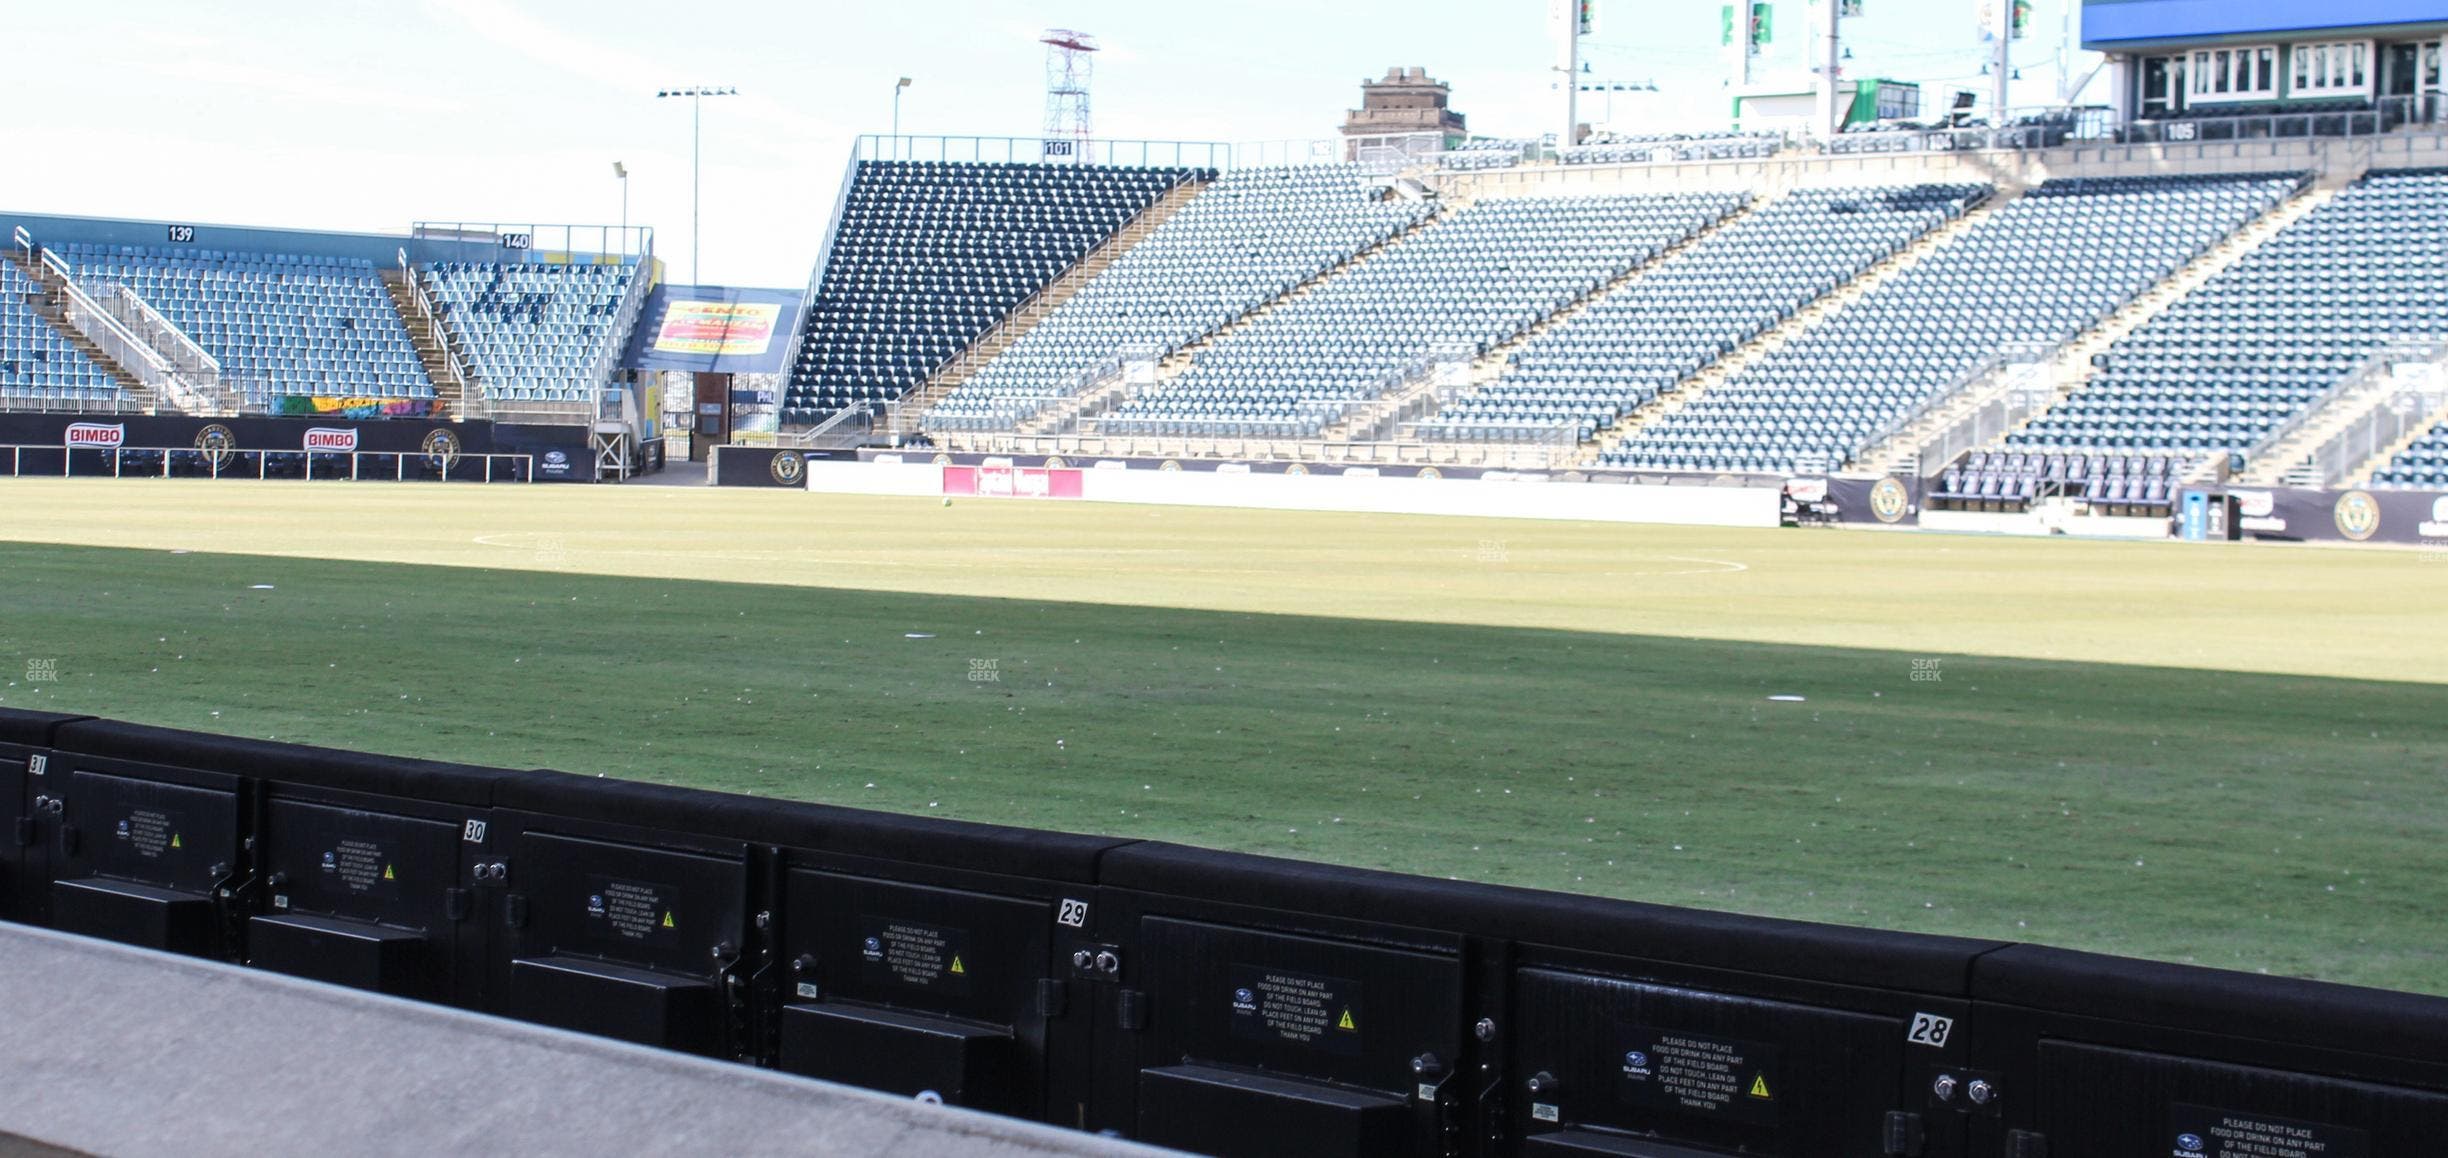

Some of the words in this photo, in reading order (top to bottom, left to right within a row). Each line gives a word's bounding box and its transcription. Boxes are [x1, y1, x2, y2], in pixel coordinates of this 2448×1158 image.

[2168, 123, 2195, 140] 105
[1047, 142, 1071, 154] 101
[170, 227, 194, 242] 139
[505, 235, 529, 248] 140
[70, 429, 120, 442] BIMBO
[308, 434, 354, 446] BIMBO
[31, 757, 44, 772] 31
[466, 822, 484, 840] 30
[1061, 902, 1084, 924] 29
[1266, 975, 1286, 984] PLEASE
[1307, 980, 1324, 989] PLACE
[1258, 982, 1272, 990] FOOD
[1281, 985, 1297, 994] DRINK
[1319, 991, 1332, 999] PART
[1286, 995, 1301, 1004] FIELD
[1272, 1002, 1283, 1010] NOT
[1304, 1007, 1318, 1015] LEAN
[1262, 1009, 1279, 1018] PLACE
[1280, 1012, 1293, 1020] FEET
[1314, 1017, 1328, 1026] PART
[1287, 1022, 1302, 1031] FIELD
[1912, 1018, 1947, 1043] 28
[1281, 1029, 1298, 1039] THANK
[1300, 1033, 1310, 1041] YOU
[1662, 1036, 1686, 1047] PLEASE
[1688, 1040, 1697, 1048] DO
[1698, 1041, 1710, 1050] NOT
[1712, 1043, 1732, 1053] PLACE
[1652, 1044, 1670, 1053] FOOD
[1670, 1047, 1680, 1055] OR
[1680, 1048, 1700, 1058] DRINK
[1701, 1051, 1712, 1059] ON
[1712, 1053, 1725, 1061] ANY
[1726, 1055, 1742, 1064] PART
[1664, 1056, 1672, 1064] OF
[1674, 1057, 1686, 1066] THE
[1686, 1059, 1705, 1069] FIELD
[1623, 1066, 1650, 1075] SUBARU
[1660, 1065, 1669, 1074] DO
[1670, 1067, 1682, 1076] NOT
[1708, 1072, 1725, 1082] LEAN
[1726, 1075, 1736, 1083] OR
[1658, 1074, 1678, 1084] PLACE
[1680, 1077, 1695, 1087] FEET
[1696, 1080, 1706, 1088] ON
[1707, 1082, 1720, 1090] ANY
[1721, 1084, 1737, 1093] PART
[1664, 1085, 1672, 1093] OF
[1674, 1087, 1686, 1096] THE
[1688, 1089, 1706, 1098] FIELD
[1680, 1096, 1702, 1107] THANK
[1704, 1100, 1716, 1110] YOU
[2224, 1118, 2252, 1130] PLEASE
[2255, 1123, 2266, 1132] DO
[2268, 1125, 2284, 1134] NOT
[2286, 1128, 2312, 1138] PLACE
[2210, 1126, 2232, 1137] FOOD
[2234, 1130, 2244, 1138] OR
[2246, 1132, 2271, 1143] DRINK
[2272, 1136, 2284, 1145] ON
[2286, 1138, 2302, 1148] ANY
[2304, 1141, 2325, 1151] PART
[2224, 1140, 2234, 1148] OF
[2237, 1142, 2252, 1151] THE
[2254, 1144, 2277, 1155] FIELD
